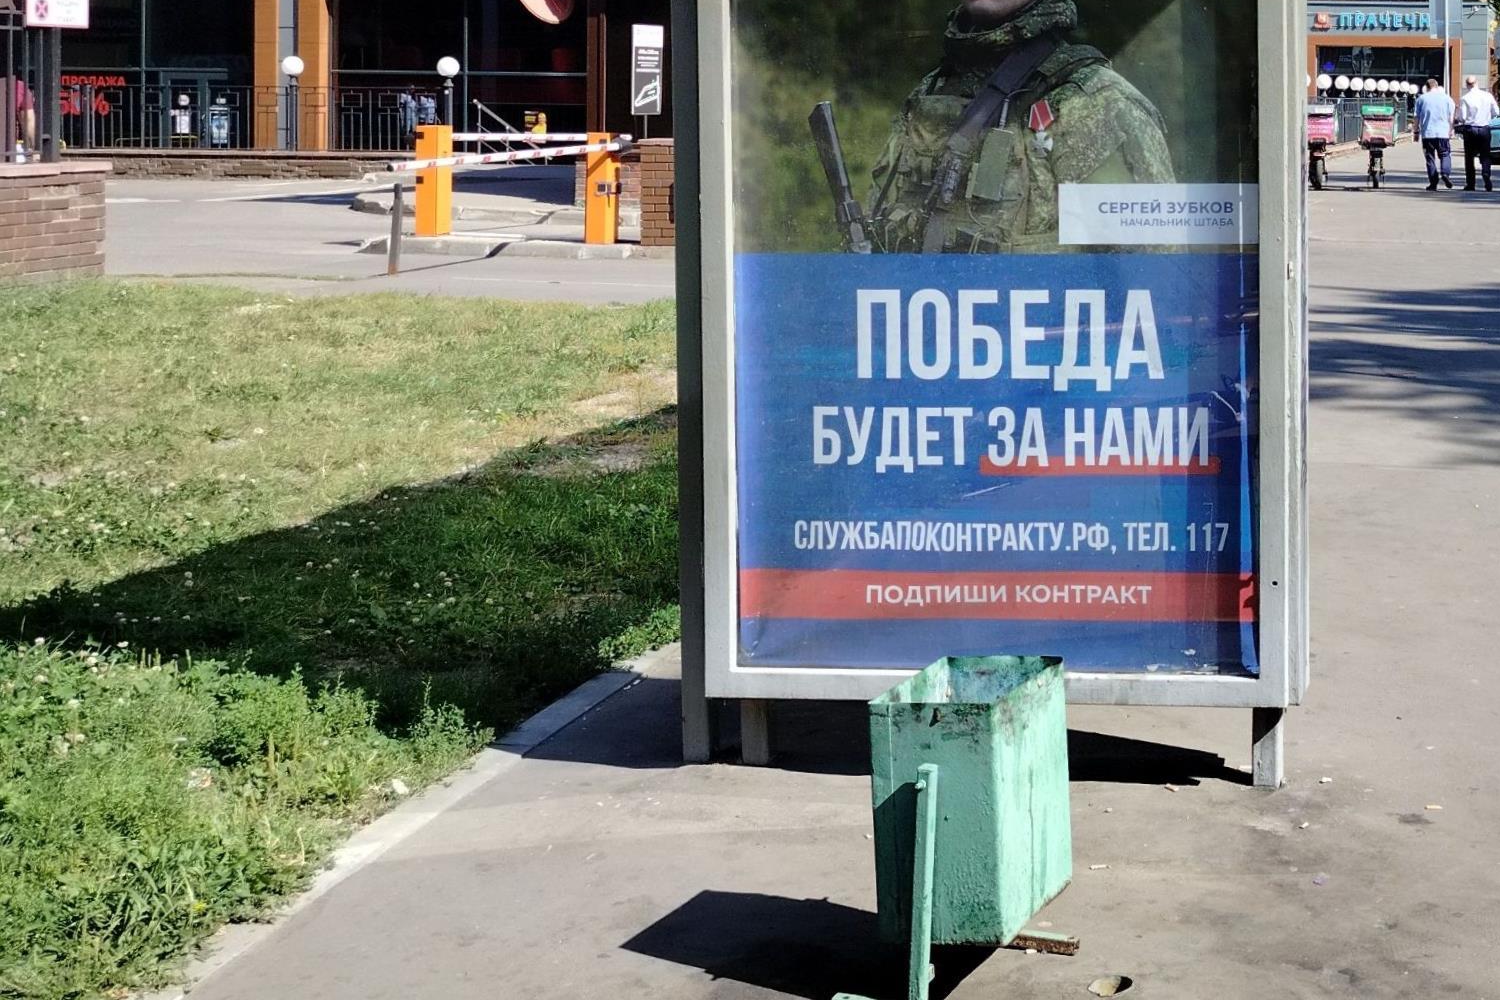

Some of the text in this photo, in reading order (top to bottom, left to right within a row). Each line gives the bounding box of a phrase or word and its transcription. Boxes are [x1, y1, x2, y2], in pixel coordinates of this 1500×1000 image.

[1098, 199, 1234, 214] СЕРГЕЙ ЗУБКОВ
[1120, 218, 1234, 227] НАЧАЛЬНИК ШТАБА
[856, 289, 1165, 391] ПОБЕДА
[812, 406, 1209, 473] БУДЕТ ЗА НАМИ
[794, 520, 1229, 555] СЛУЖБАПОКОНТРАКТУ.РФ, ТЕЛ. 117
[866, 584, 1152, 605] ПОДПИШИ КОНТРАКТ
